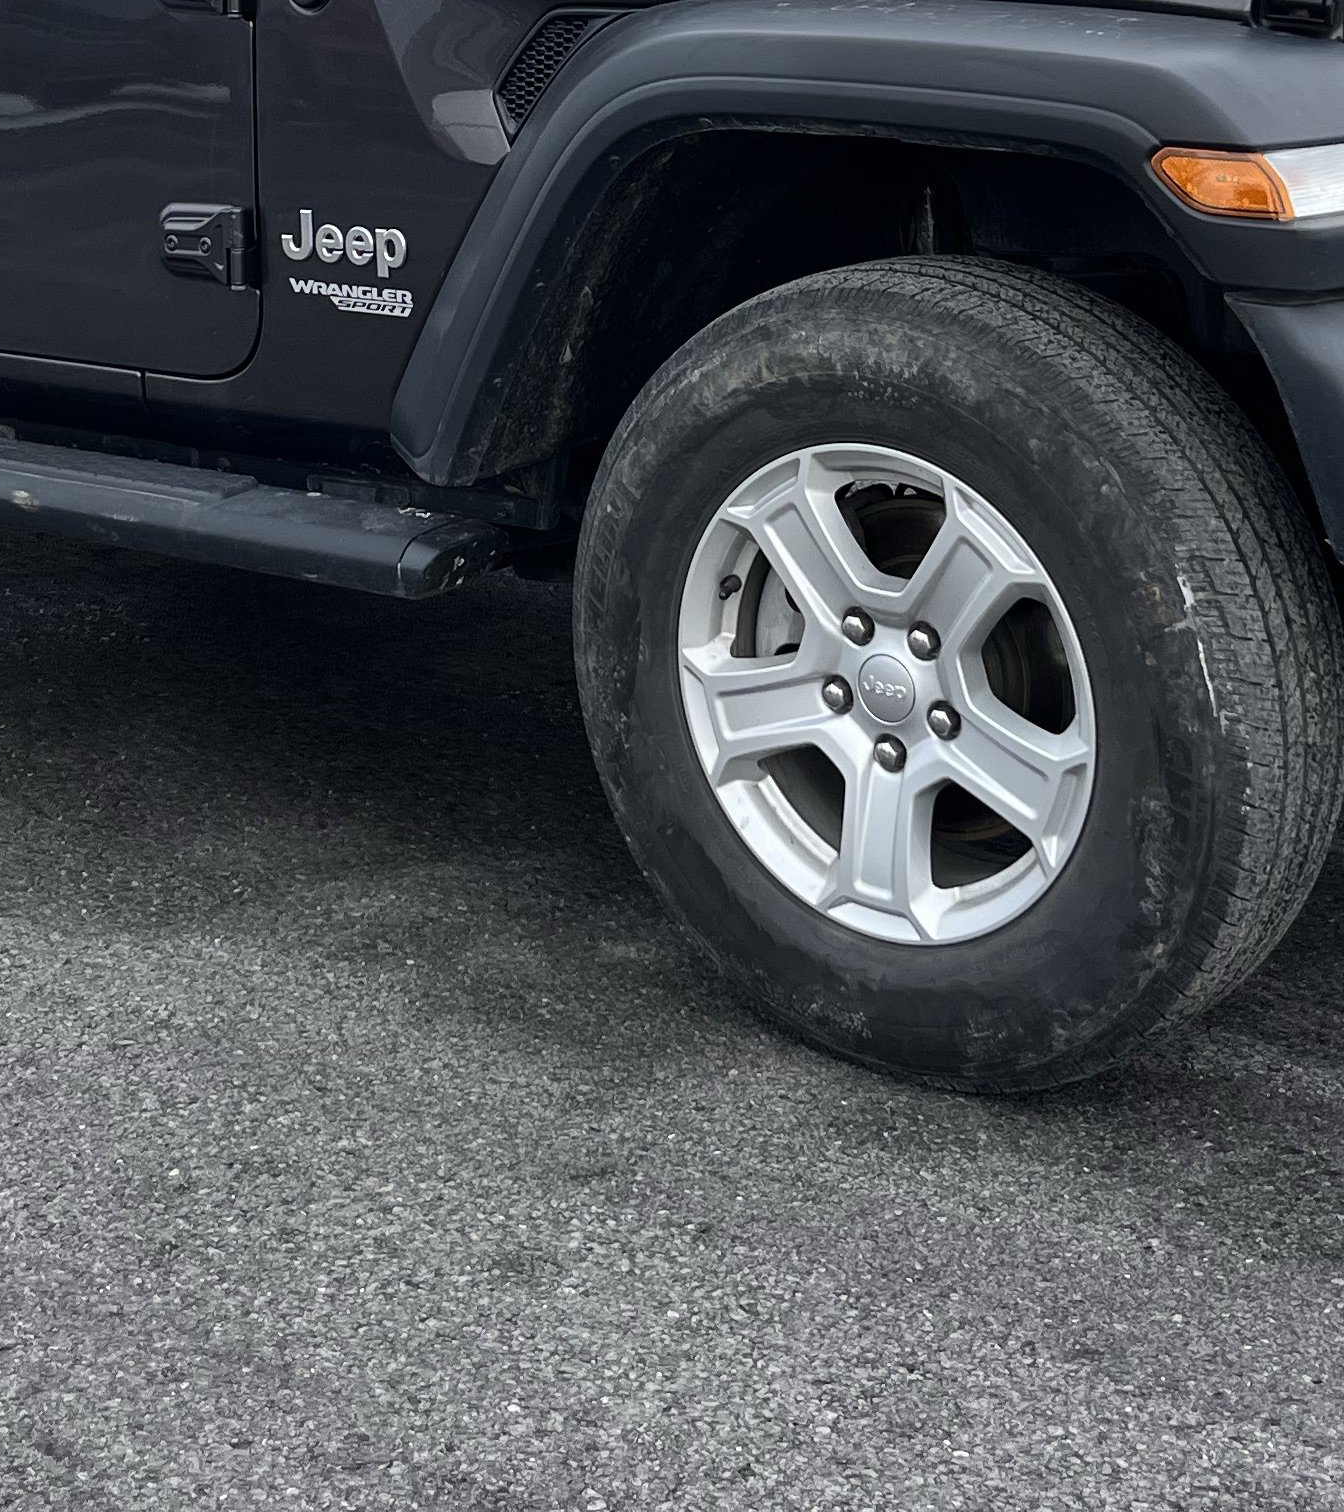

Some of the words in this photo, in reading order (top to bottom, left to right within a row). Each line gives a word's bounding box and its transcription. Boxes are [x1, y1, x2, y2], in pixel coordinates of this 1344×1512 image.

[281, 209, 407, 278] Jeep
[289, 277, 413, 304] WRANGLER
[335, 298, 409, 315] SPORT
